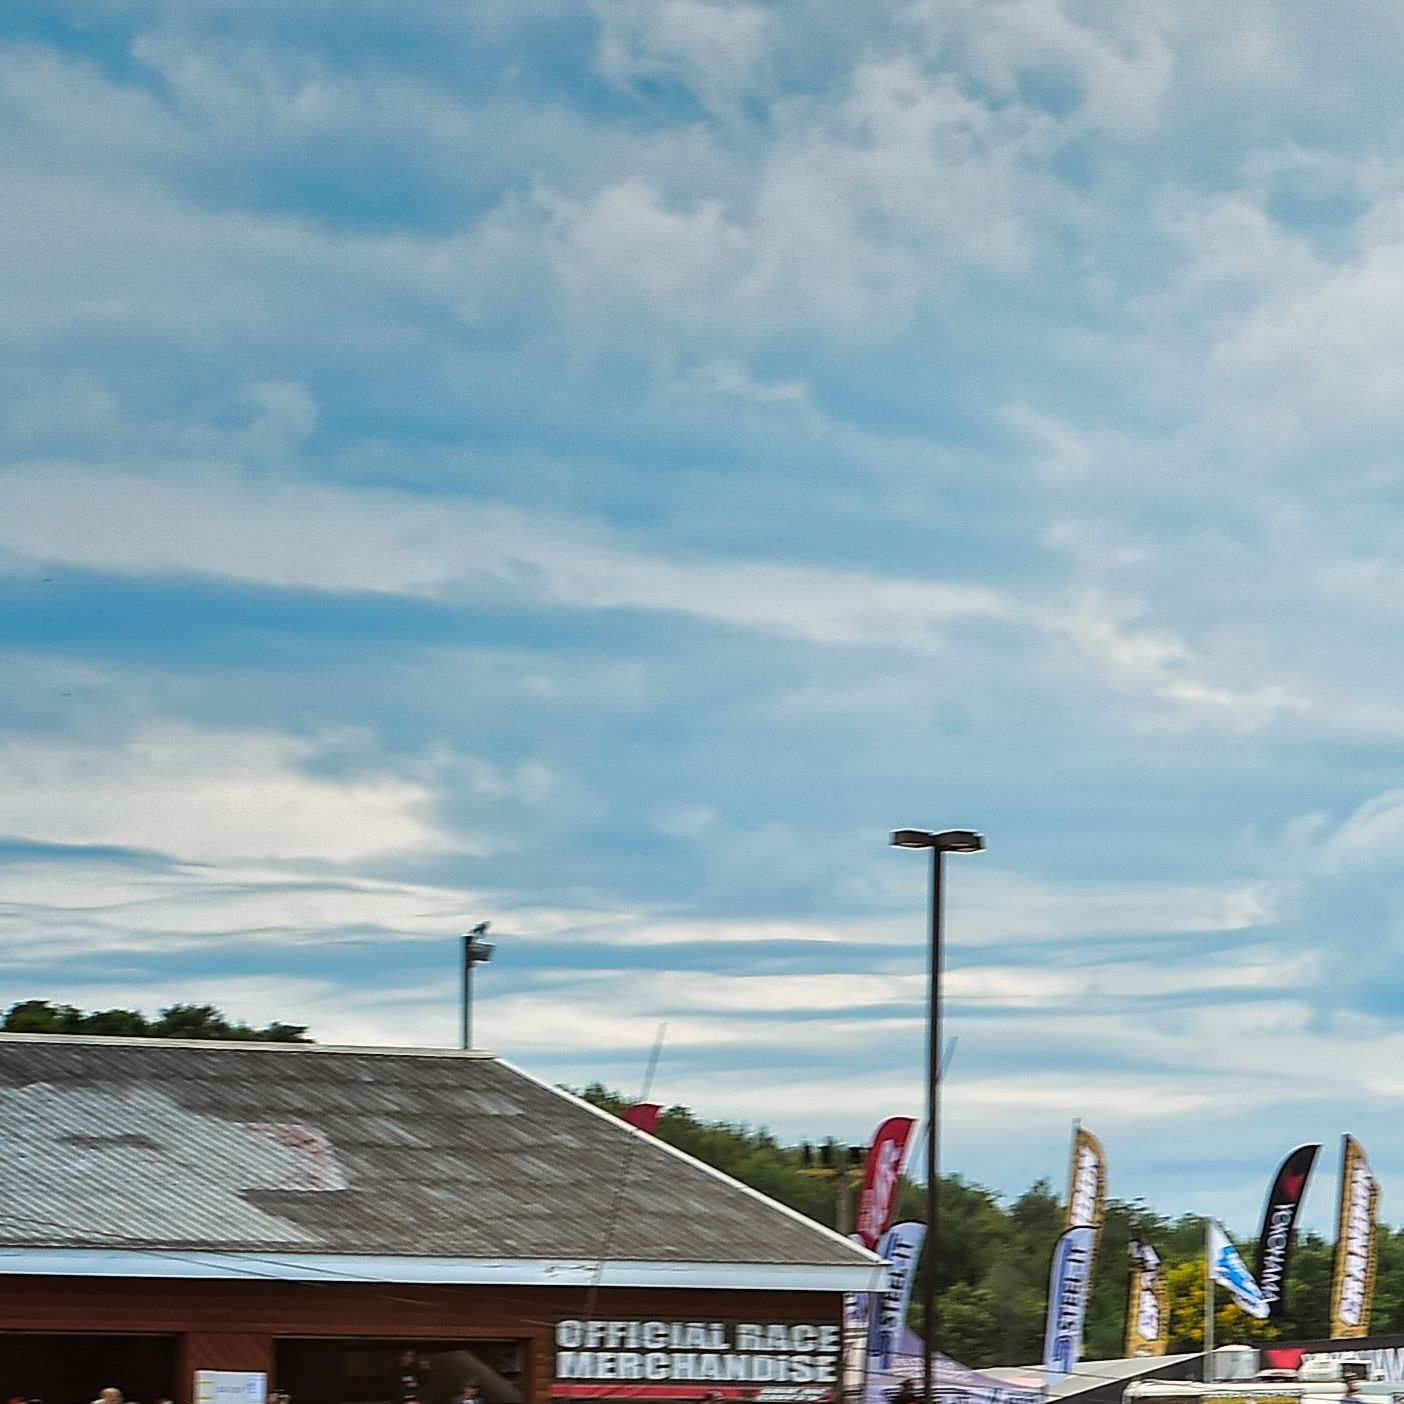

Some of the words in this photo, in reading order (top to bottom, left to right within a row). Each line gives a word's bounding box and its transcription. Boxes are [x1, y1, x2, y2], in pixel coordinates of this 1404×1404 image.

[1261, 1203, 1297, 1303] YOKOHAMA
[555, 1320, 730, 1350] OFFICIAL
[735, 1323, 840, 1350] RACE
[555, 1351, 838, 1383] MERCHANDISE
